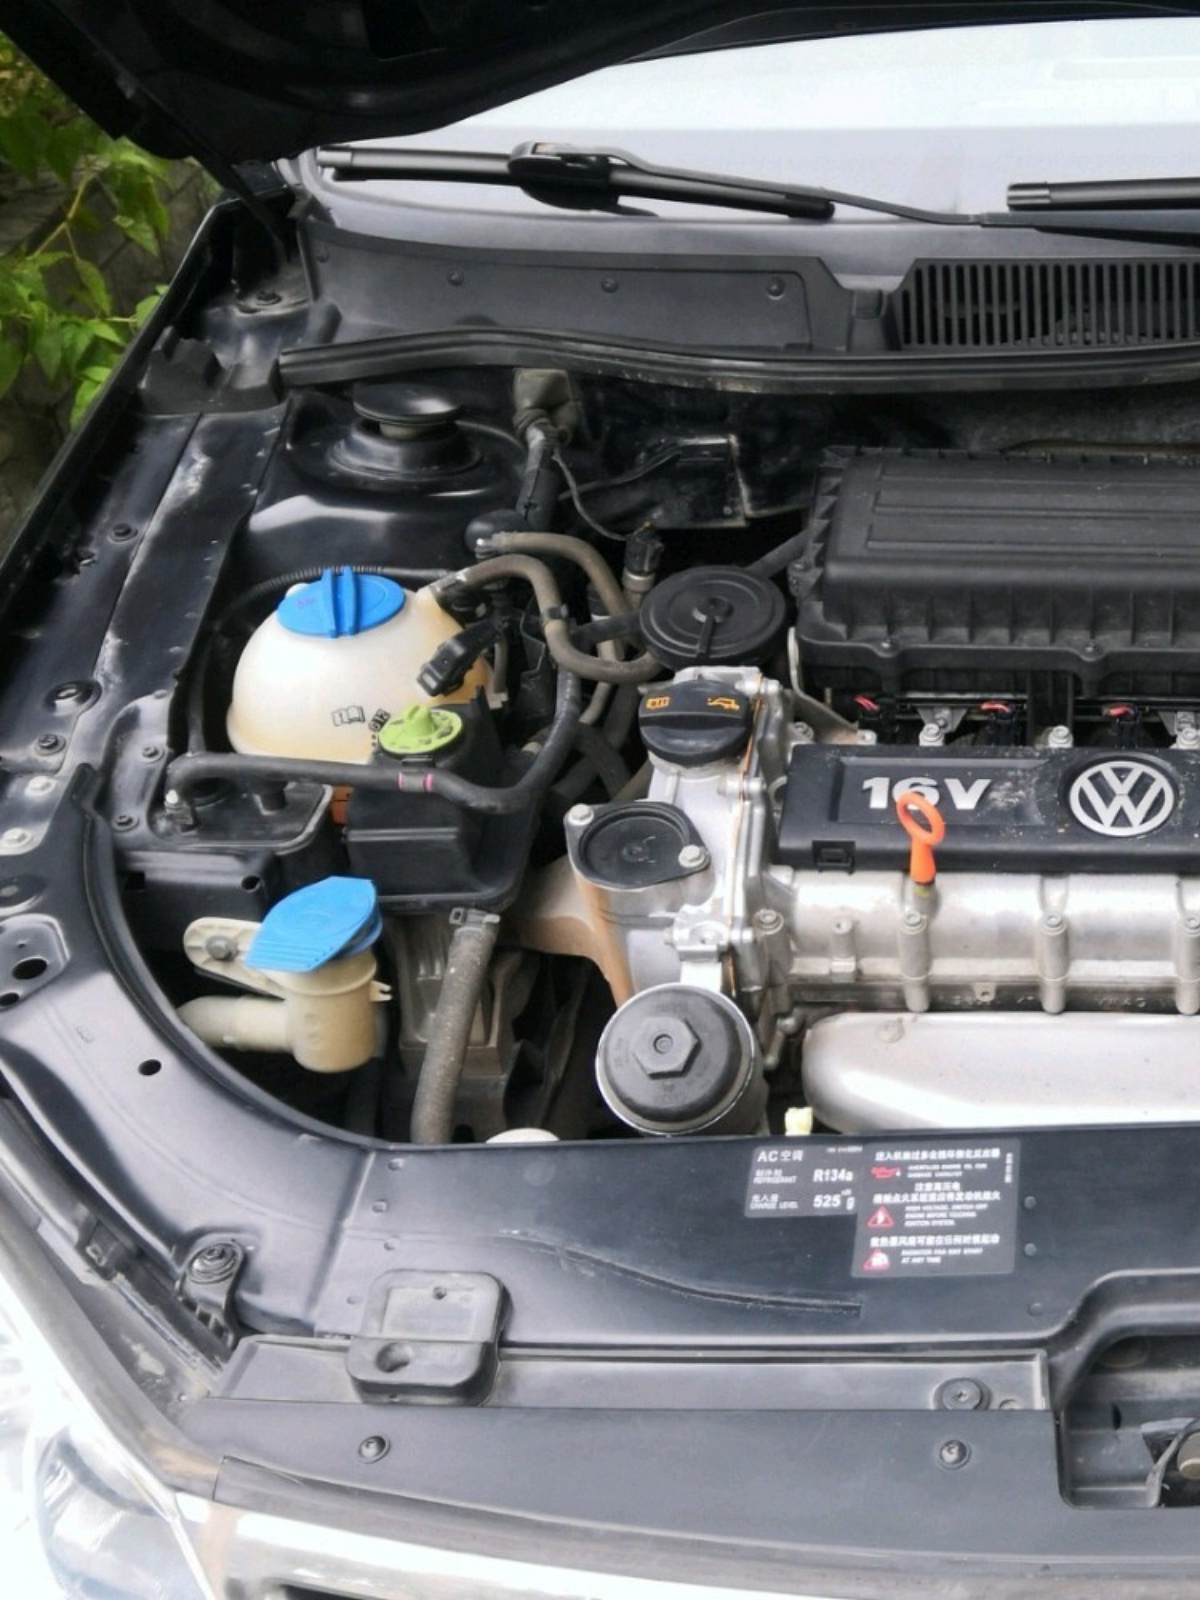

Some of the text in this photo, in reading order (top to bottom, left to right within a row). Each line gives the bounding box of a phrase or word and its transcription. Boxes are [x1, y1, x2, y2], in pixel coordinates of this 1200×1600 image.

[862, 777, 992, 811] 16V
[757, 1150, 779, 1162] AC
[812, 1168, 854, 1182] R134a
[812, 1194, 842, 1208] 525
